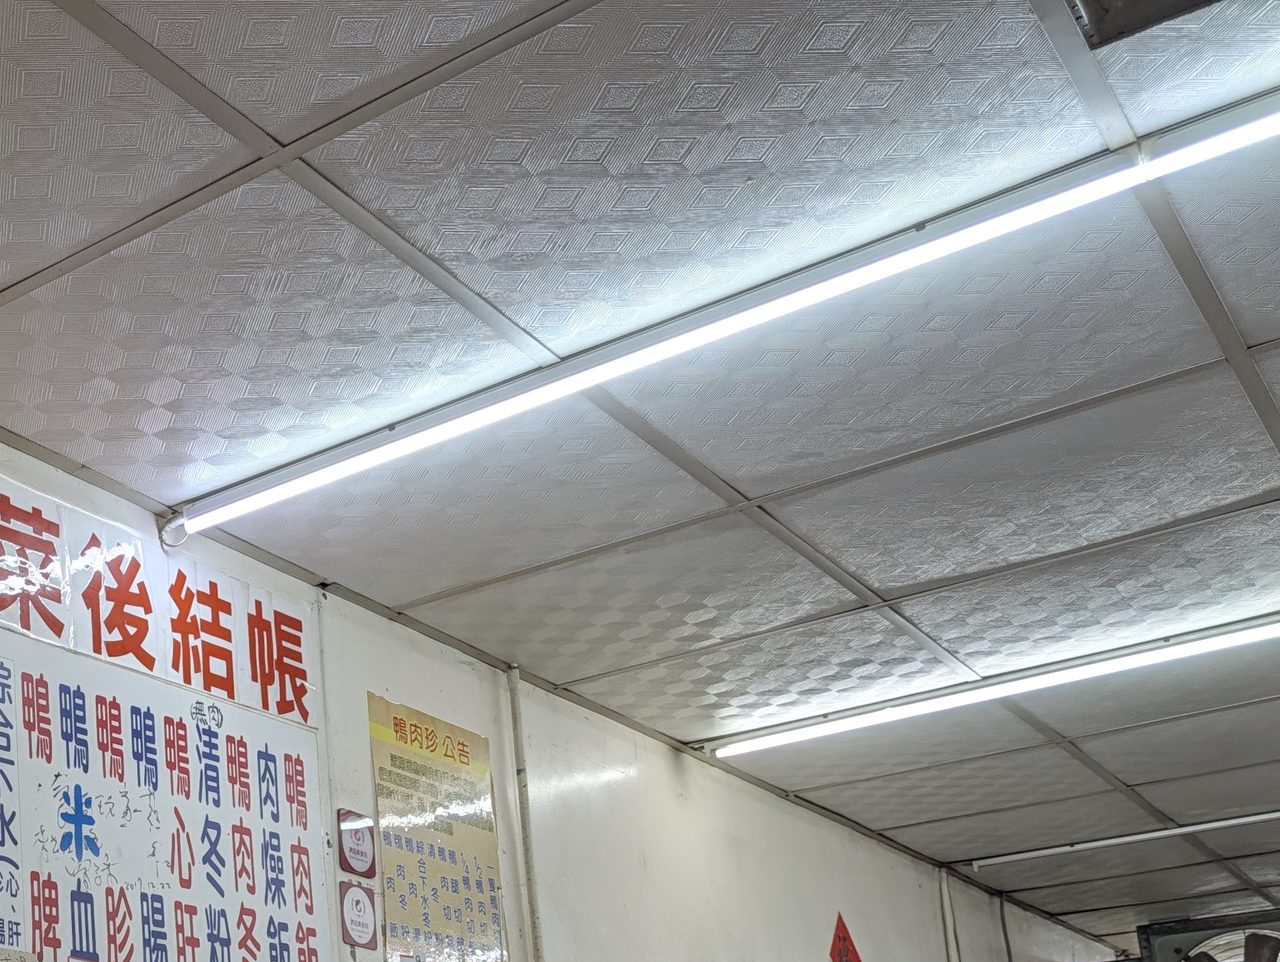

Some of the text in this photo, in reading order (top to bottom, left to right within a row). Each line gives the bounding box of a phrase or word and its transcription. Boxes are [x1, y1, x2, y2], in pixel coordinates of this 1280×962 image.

[392, 716, 470, 766] 鴨肉珍 公告
